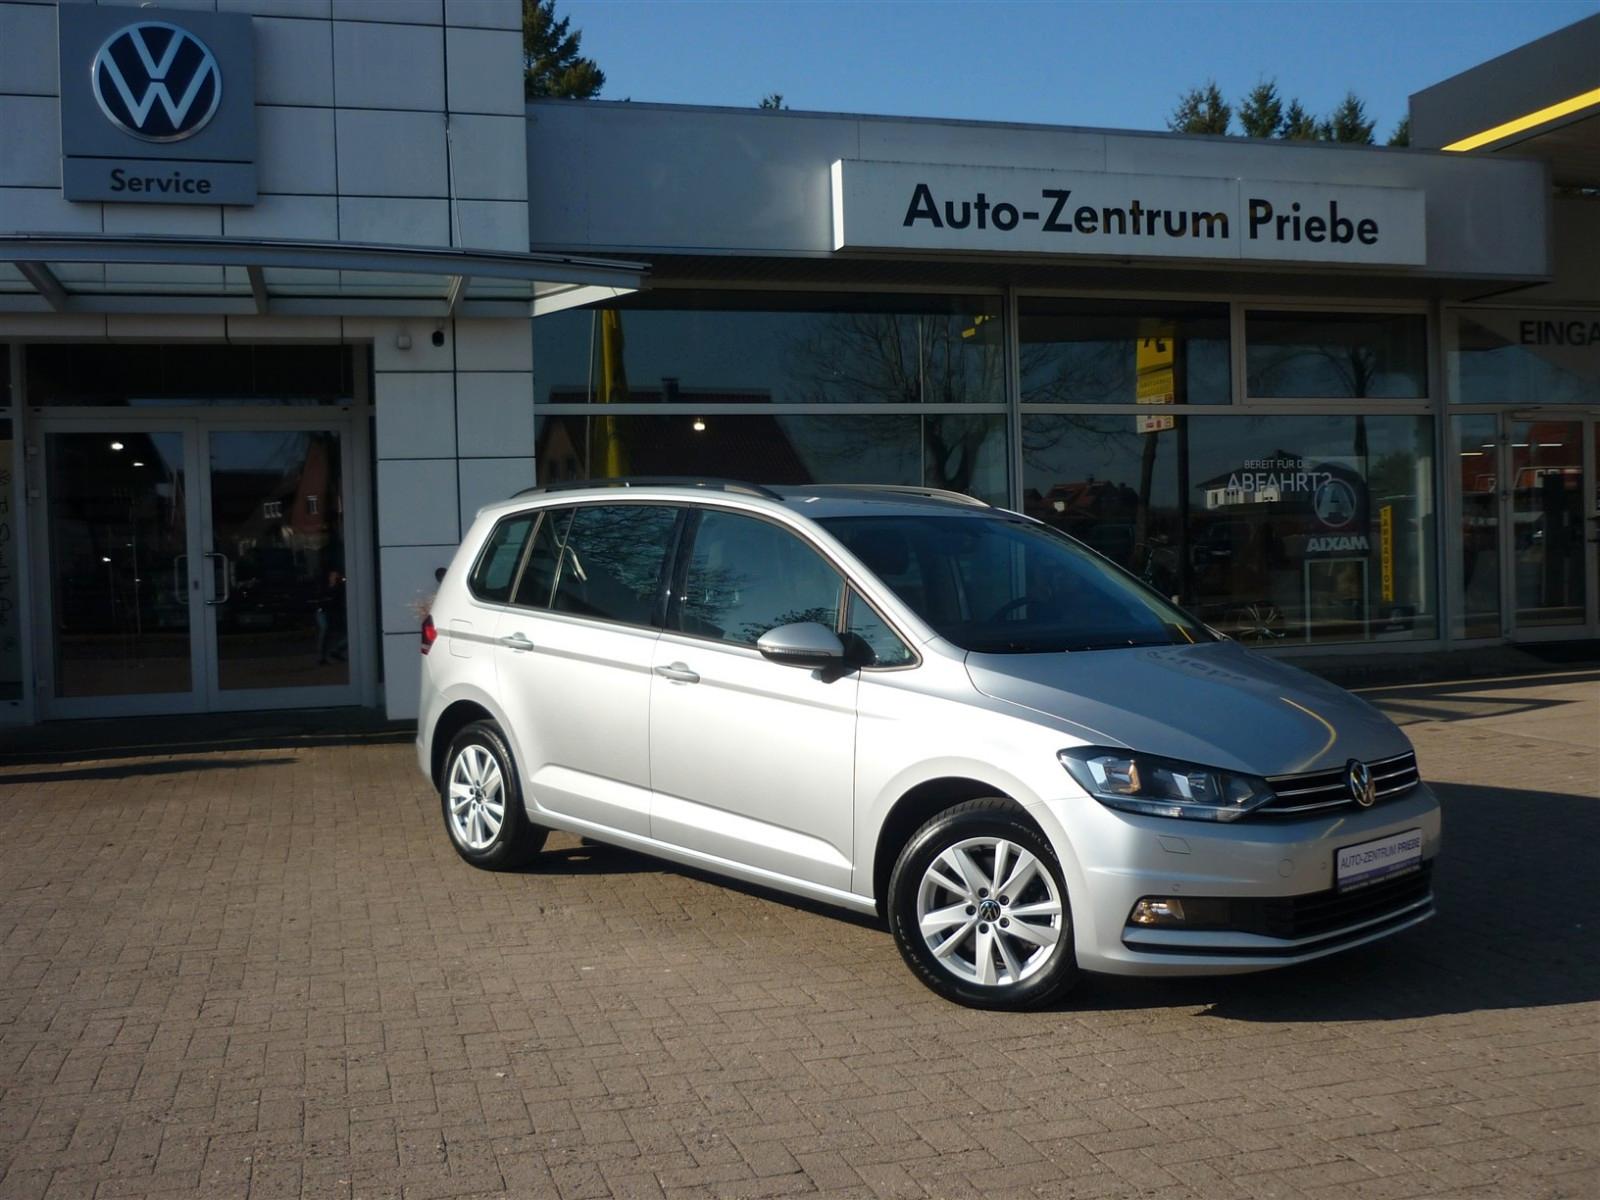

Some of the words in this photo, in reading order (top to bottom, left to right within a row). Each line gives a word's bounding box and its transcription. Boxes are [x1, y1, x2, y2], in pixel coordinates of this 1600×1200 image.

[110, 168, 211, 194] Service
[903, 183, 1229, 239] Auto-Zentrum
[1248, 198, 1379, 245] Priebe
[1520, 320, 1600, 346] EINGA
[1244, 459, 1275, 470] BEREIT
[1277, 457, 1295, 470] FÜR
[1227, 472, 1332, 492] ABFAHRT?
[1305, 536, 1369, 553] AIXAM
[1341, 845, 1397, 868] AUTO-ZENTRUM
[1397, 837, 1421, 855] PRIEBE
